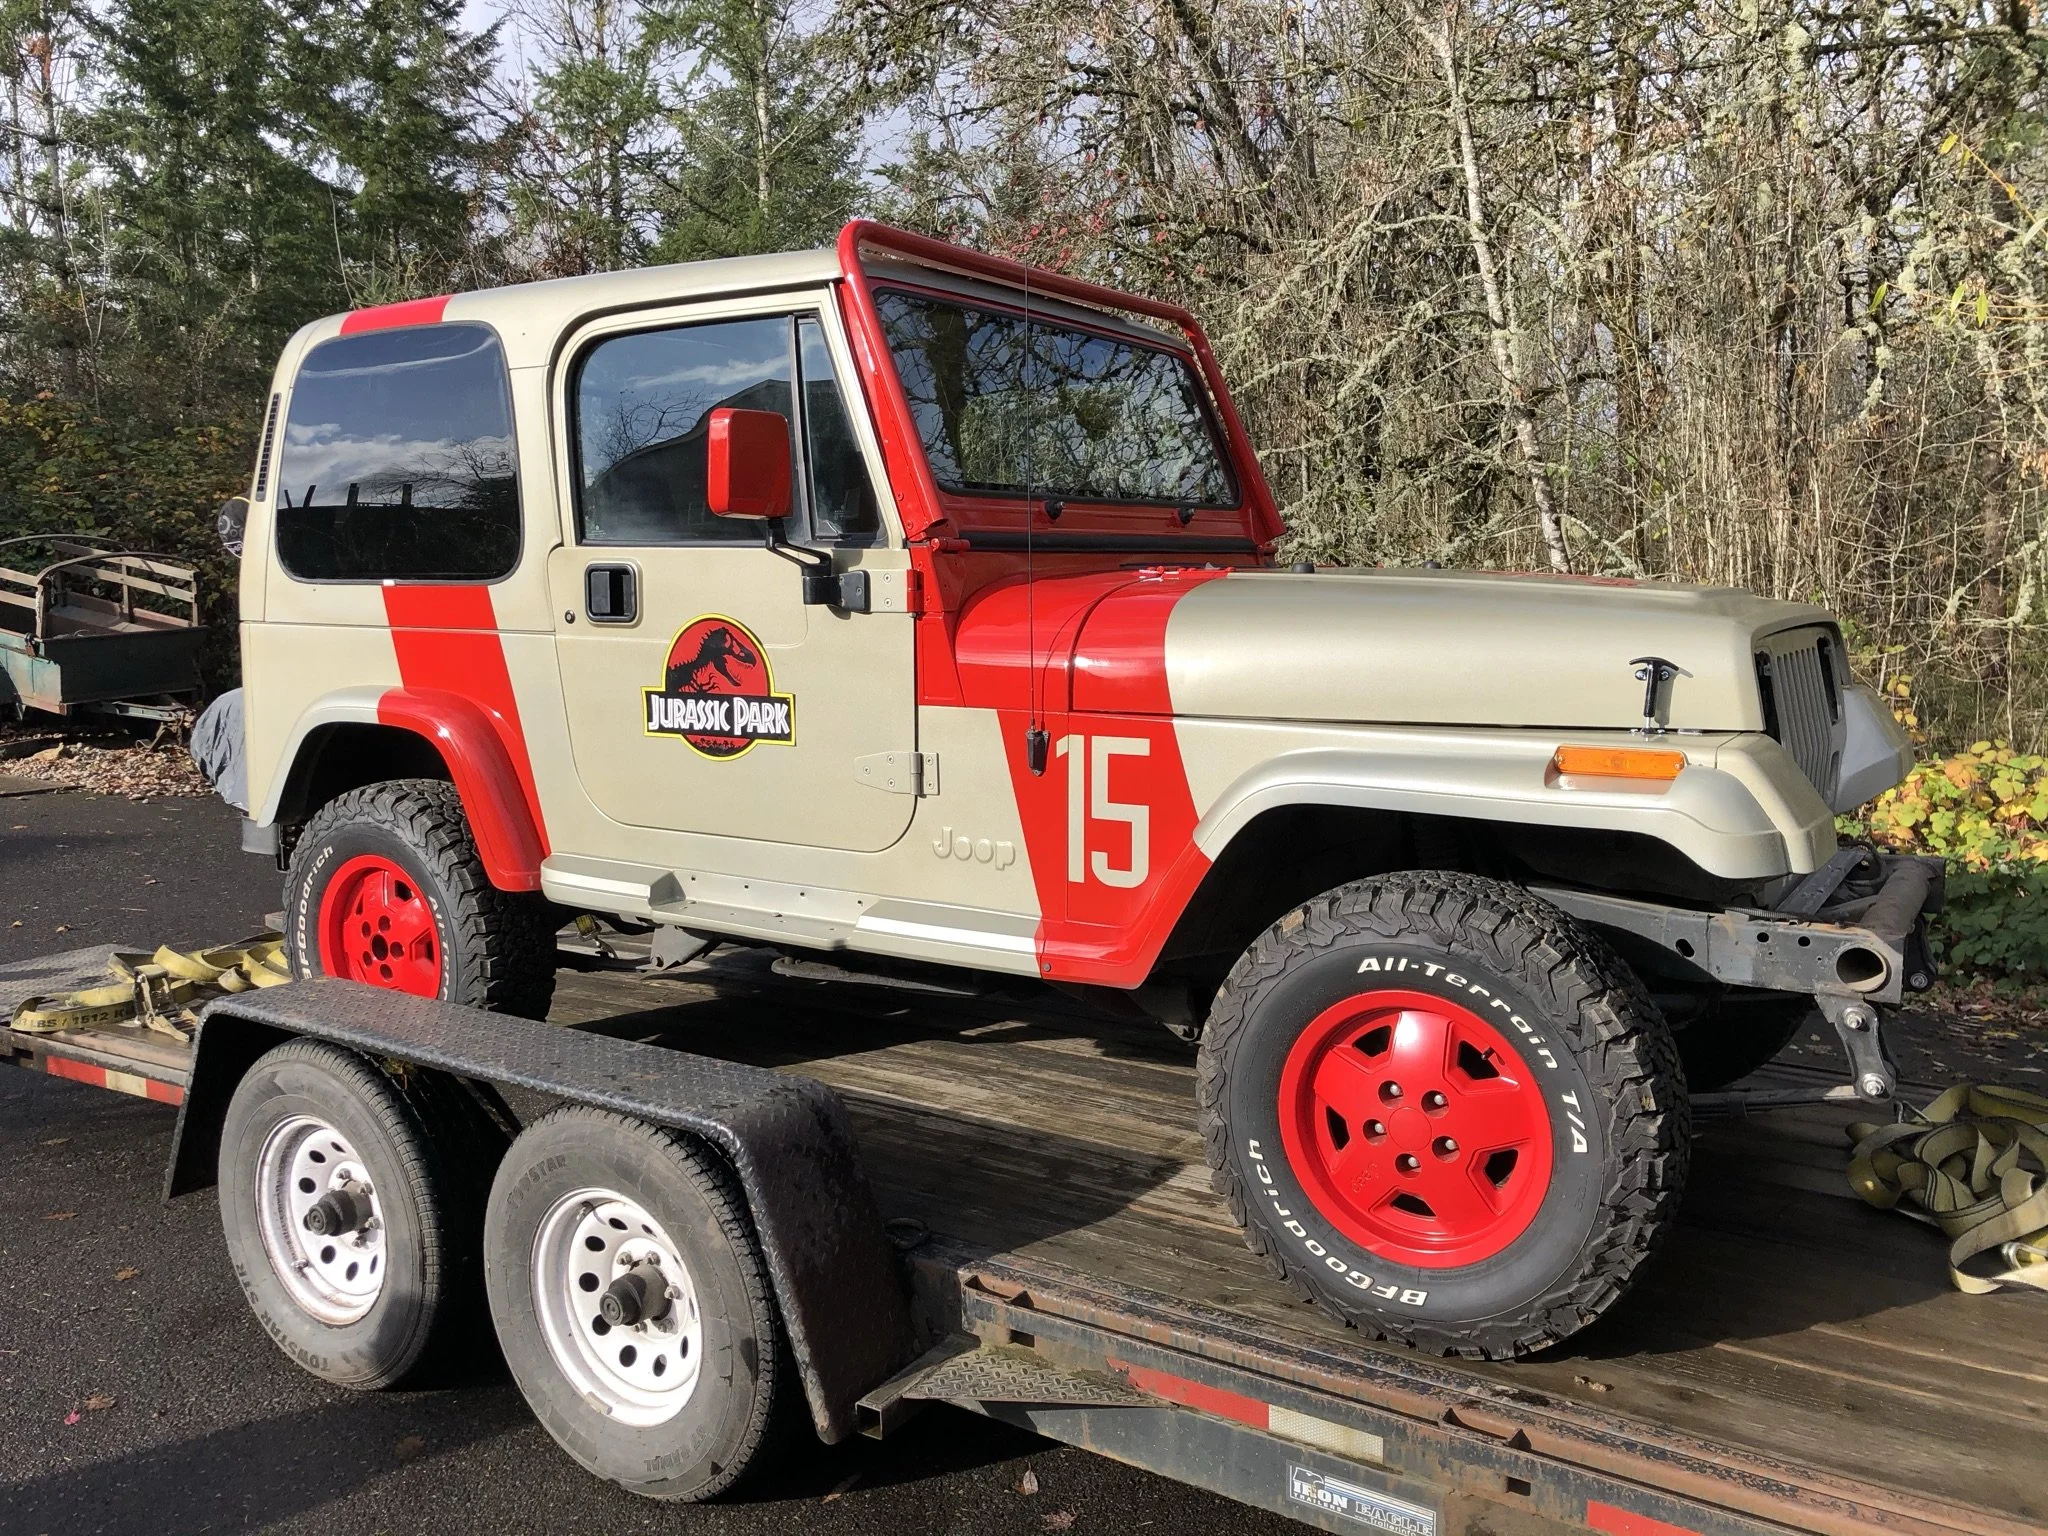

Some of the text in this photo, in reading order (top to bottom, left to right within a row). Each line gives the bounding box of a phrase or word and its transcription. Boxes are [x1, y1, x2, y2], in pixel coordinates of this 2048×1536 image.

[648, 695, 791, 736] JURASSIC PARK
[1056, 734, 1150, 889] 15
[1357, 957, 1588, 1153] All-Terrain T/A
[1249, 1139, 1428, 1306] BFGoodrich
[1293, 1492, 1342, 1512] TRAILERS
[1293, 1480, 1433, 1536] IRON EAGLE
